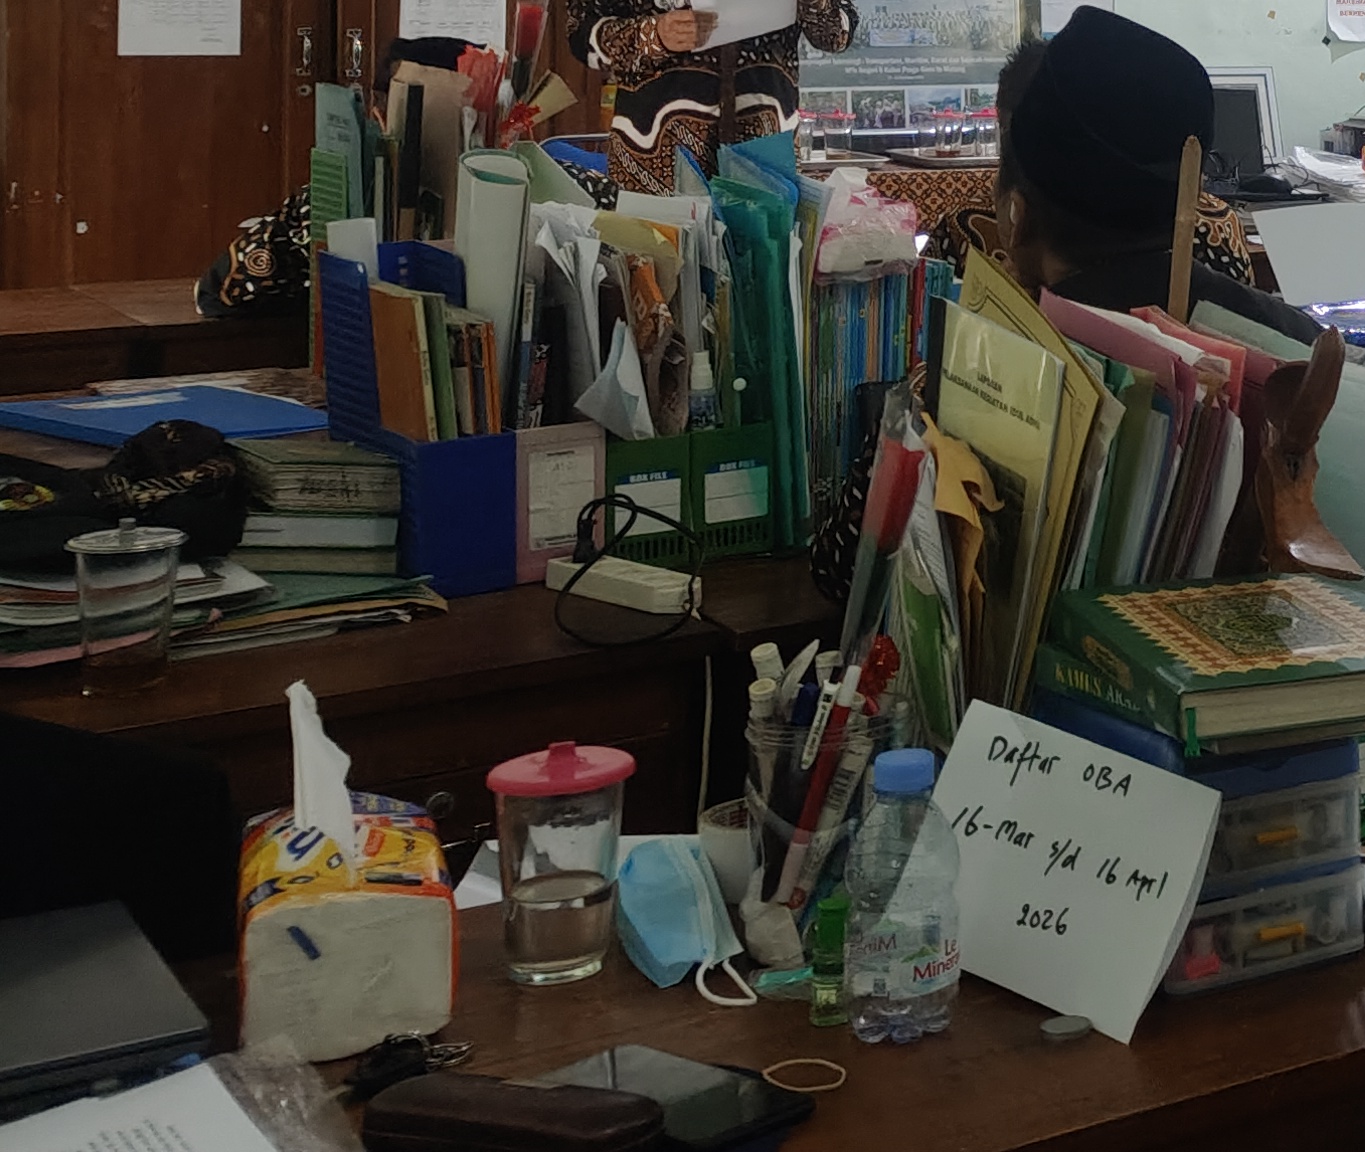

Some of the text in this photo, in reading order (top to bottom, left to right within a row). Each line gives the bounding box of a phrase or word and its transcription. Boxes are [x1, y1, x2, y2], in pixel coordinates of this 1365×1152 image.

[988, 736, 1132, 796] Daftar OBA
[952, 806, 1035, 849] 16-Mar
[1096, 857, 1121, 885] 16
[1016, 904, 1070, 936] 2026
